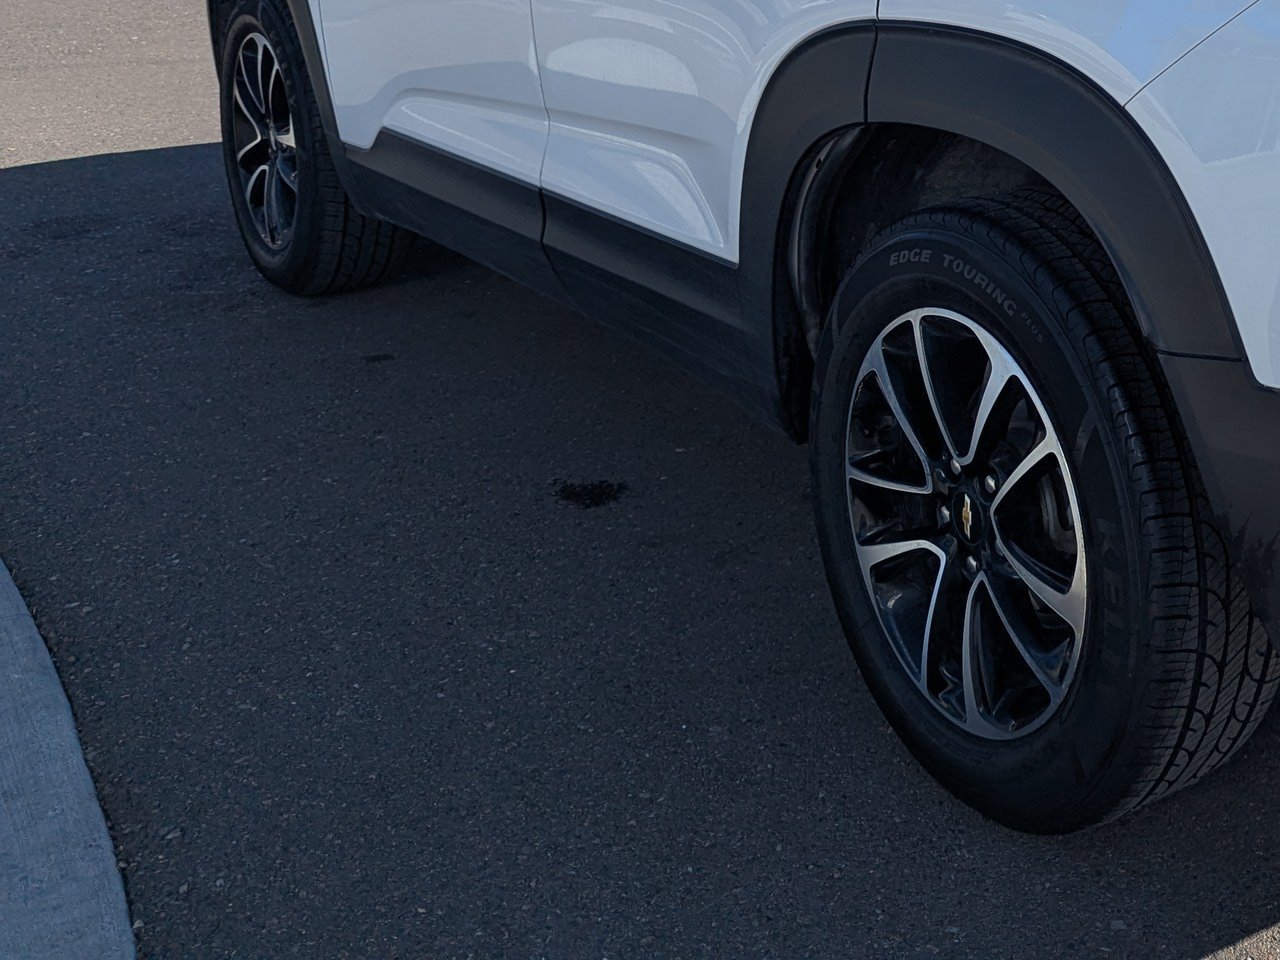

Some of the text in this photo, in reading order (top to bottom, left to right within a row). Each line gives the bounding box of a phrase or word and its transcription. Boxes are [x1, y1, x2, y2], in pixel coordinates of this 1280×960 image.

[888, 247, 1046, 345] EDGE TOURING PLUS
